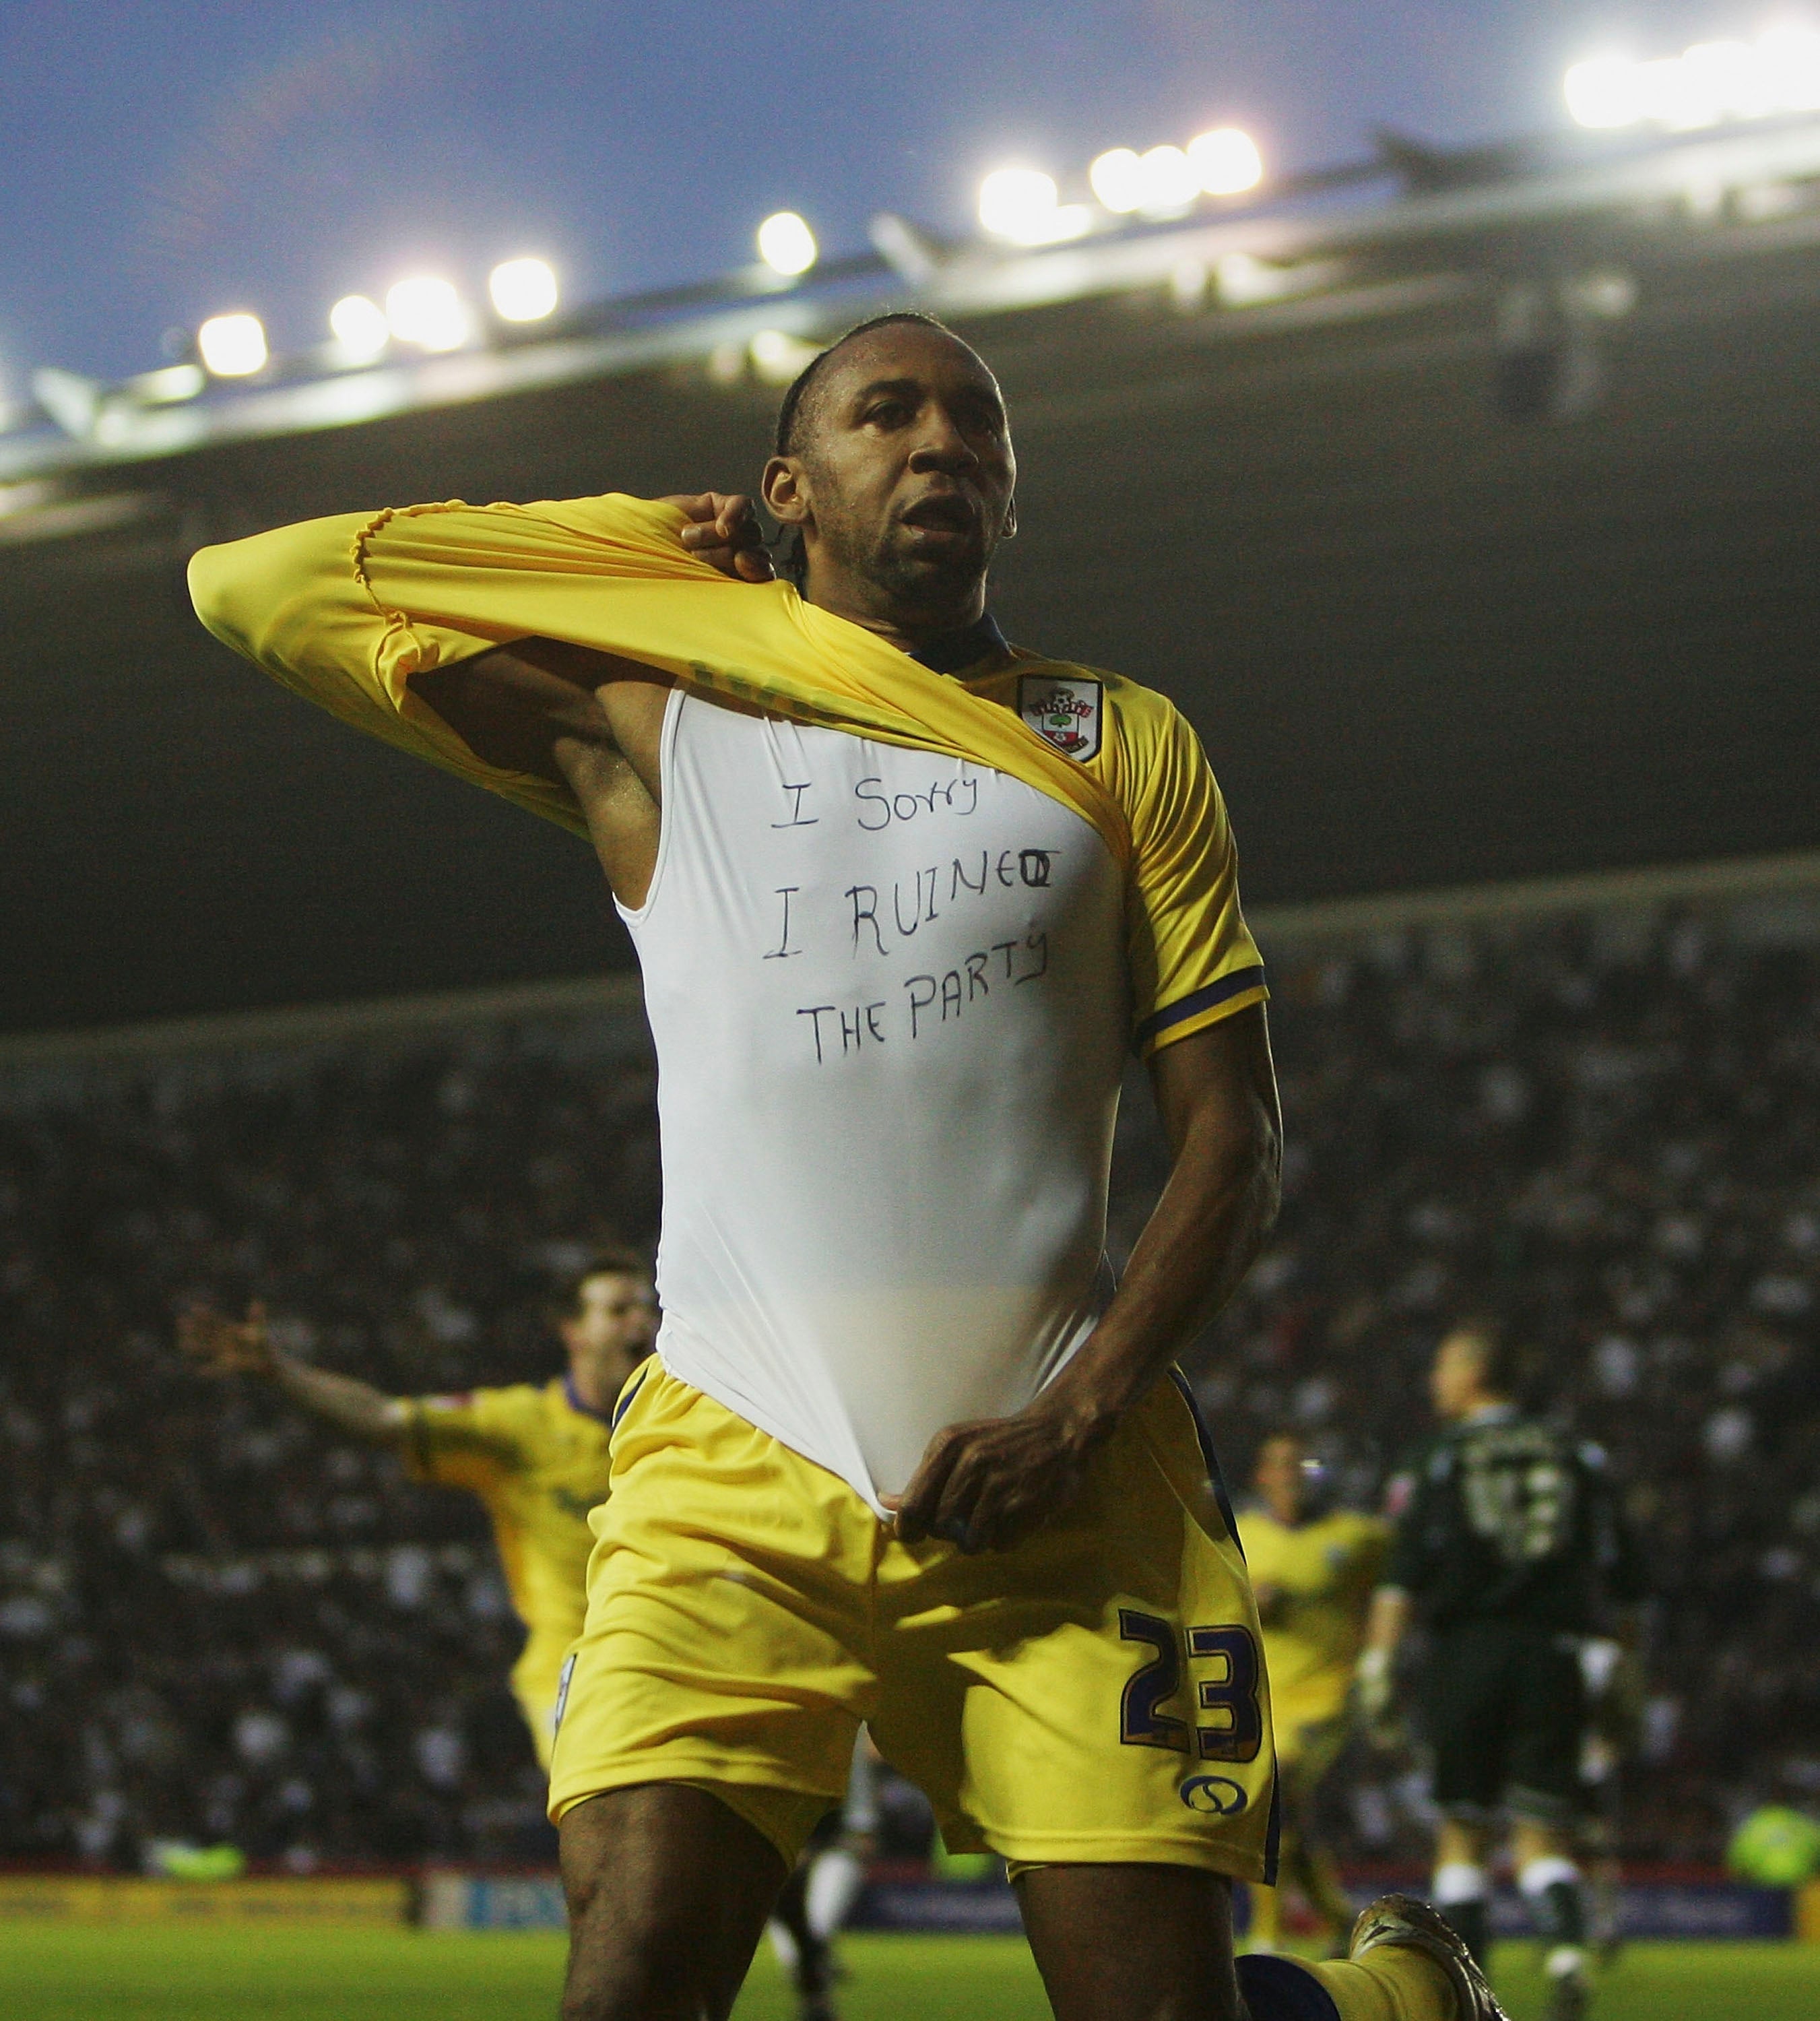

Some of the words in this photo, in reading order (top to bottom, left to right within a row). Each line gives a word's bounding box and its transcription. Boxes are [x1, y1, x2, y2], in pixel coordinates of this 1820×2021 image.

[771, 783, 819, 828] I
[855, 778, 977, 831] Sorry
[762, 887, 802, 959] I
[845, 849, 1062, 957] RUINED
[796, 1002, 886, 1065] THE
[903, 932, 1048, 1039] PARTY
[1118, 1608, 1263, 1764] 23
